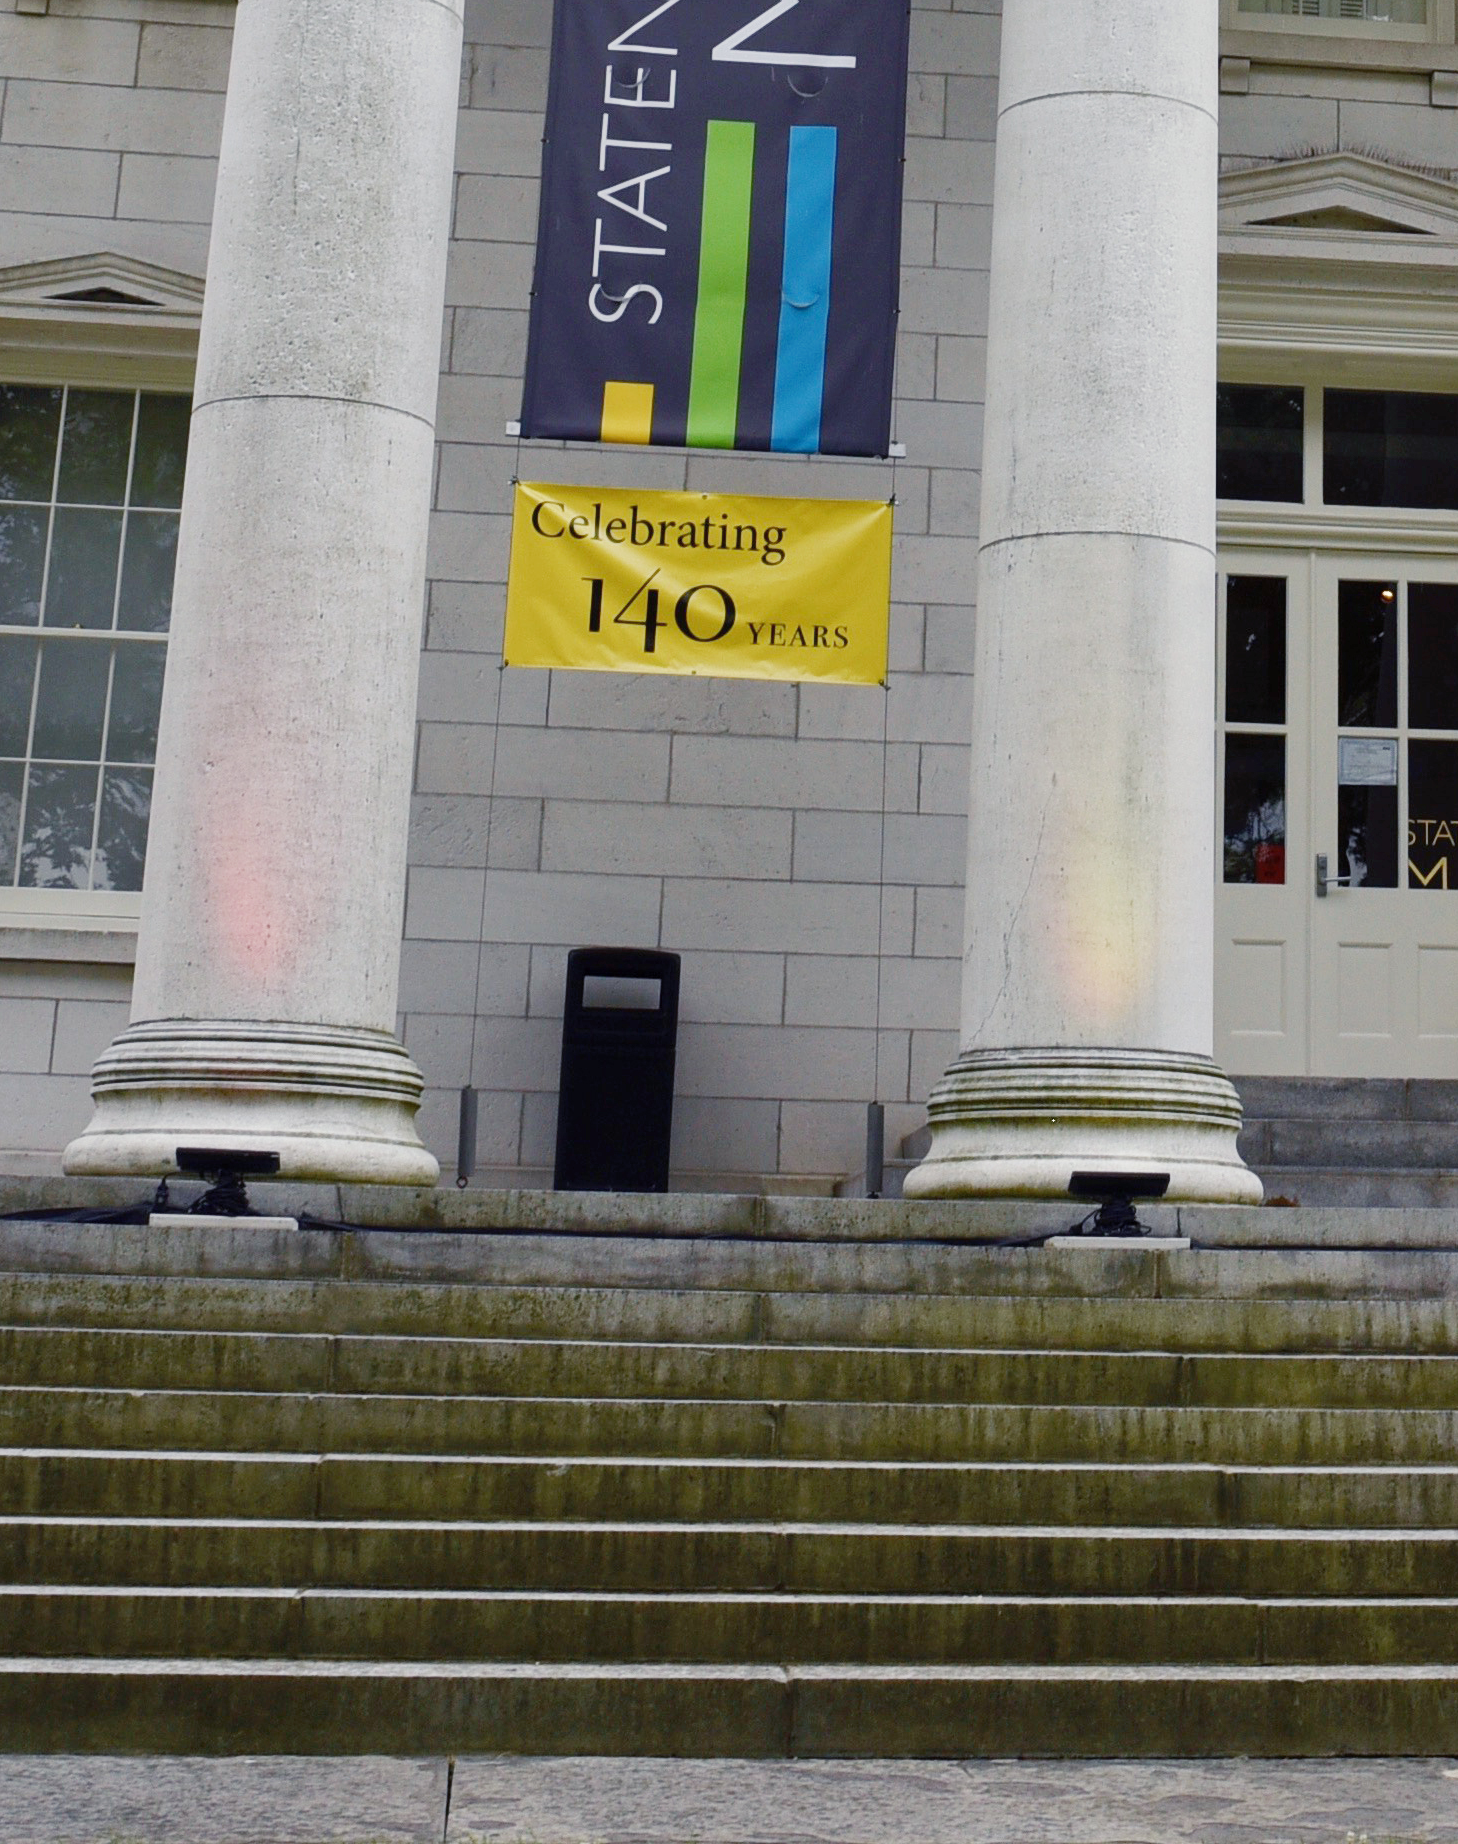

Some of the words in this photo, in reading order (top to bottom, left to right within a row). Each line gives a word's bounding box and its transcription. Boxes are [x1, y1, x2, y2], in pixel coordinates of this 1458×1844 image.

[531, 499, 787, 566] Celebrating
[581, 567, 736, 653] 140
[748, 621, 849, 649] YEARS
